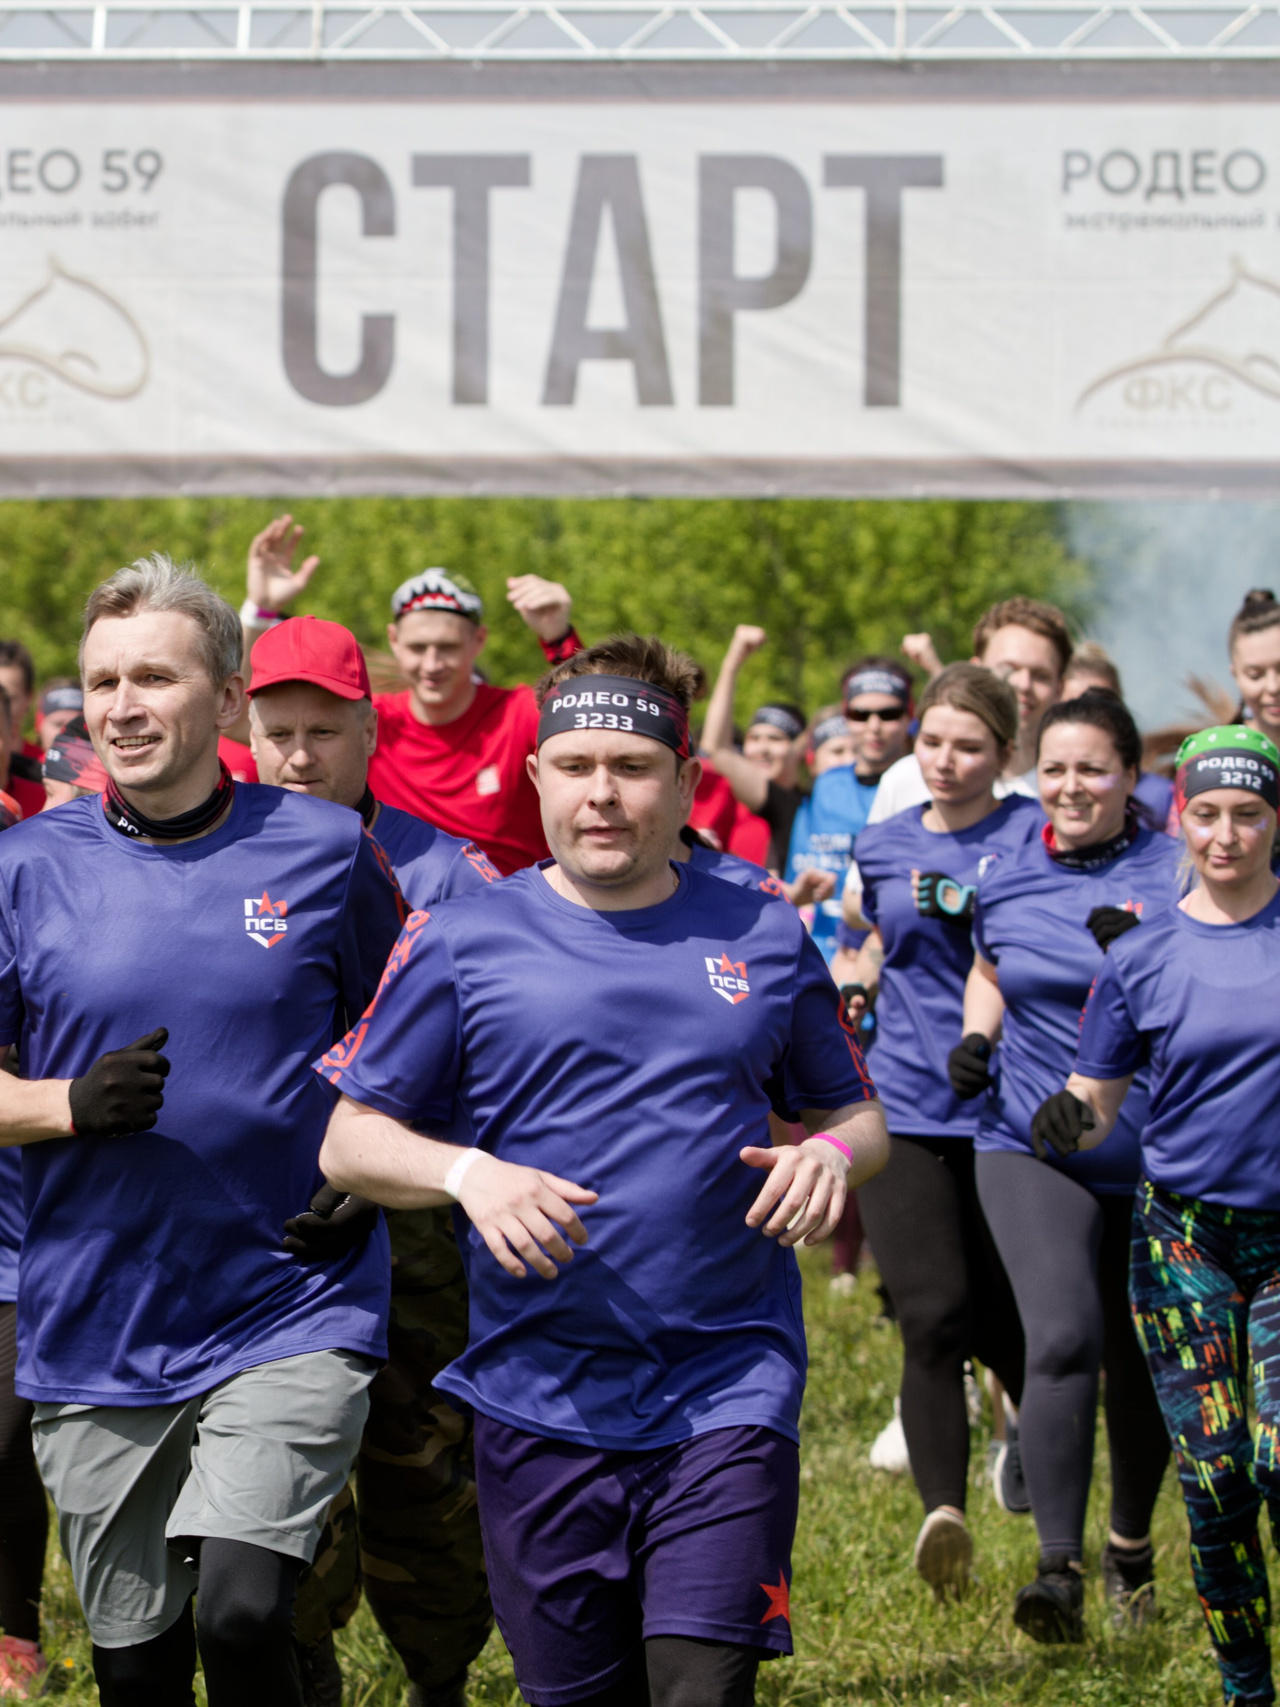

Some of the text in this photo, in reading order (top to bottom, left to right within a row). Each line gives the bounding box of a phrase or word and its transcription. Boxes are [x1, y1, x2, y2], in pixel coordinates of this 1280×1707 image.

[100, 148, 164, 194] 59
[1062, 149, 1267, 203] РОДЕО
[280, 150, 945, 409] СТАРТ
[1124, 374, 1233, 416] ФКС
[552, 691, 660, 716] РОДЕО 59
[574, 713, 634, 731] 3233
[1197, 756, 1259, 772] РОДЕО
[1220, 771, 1262, 790] 3212
[244, 918, 288, 931] ПСБ
[708, 974, 750, 992] ПСБ
